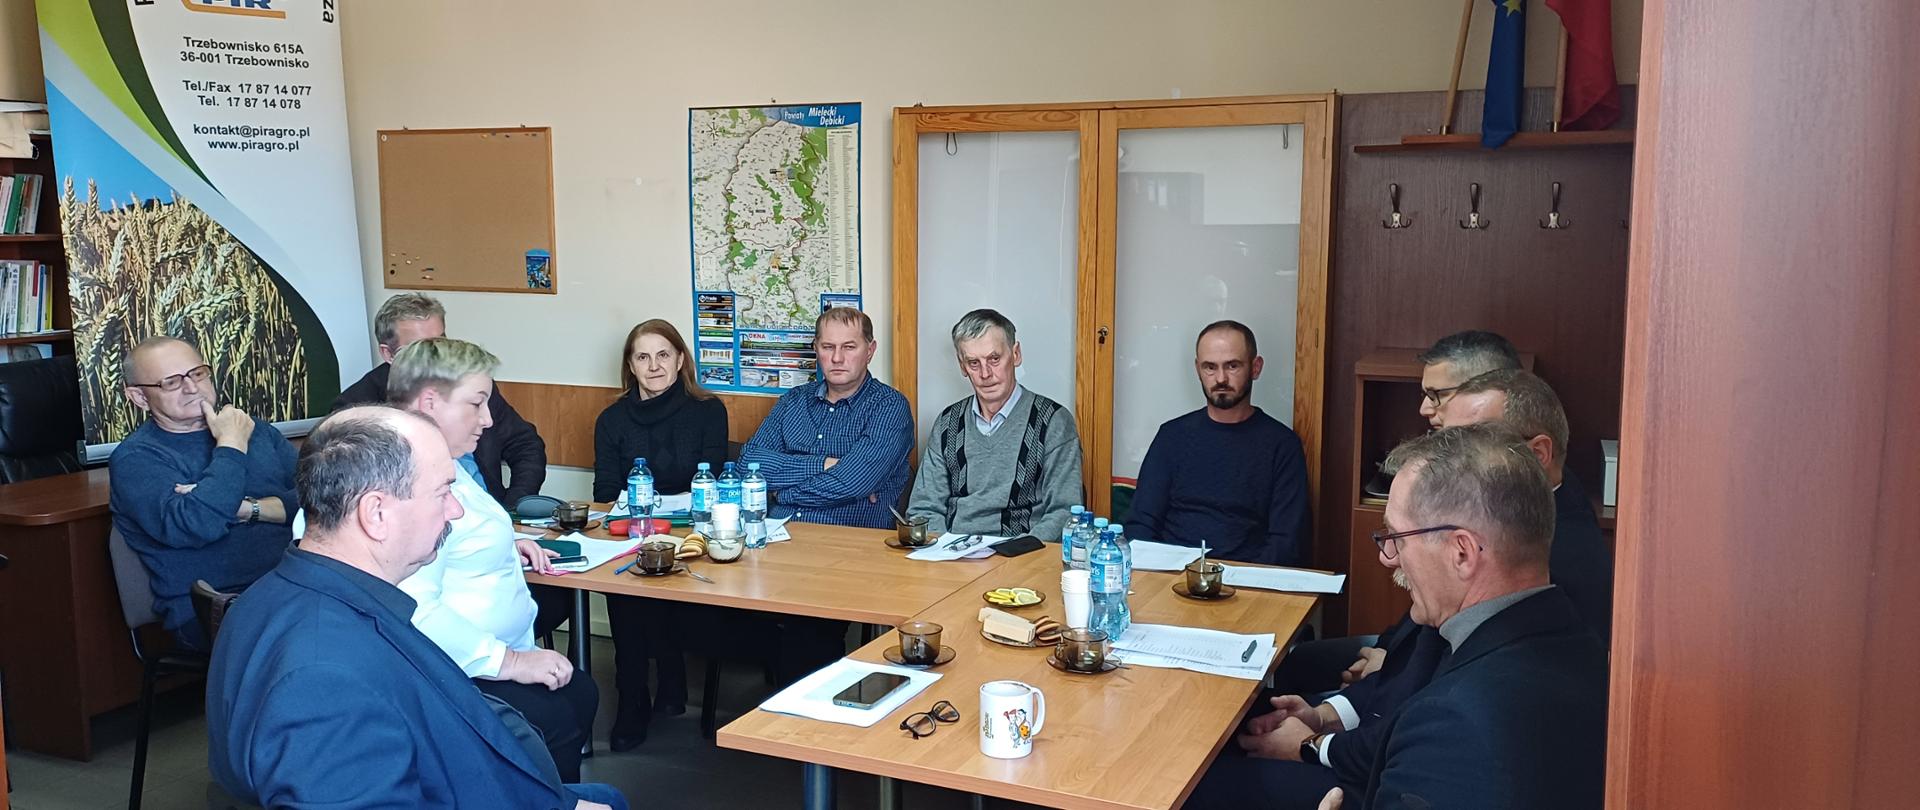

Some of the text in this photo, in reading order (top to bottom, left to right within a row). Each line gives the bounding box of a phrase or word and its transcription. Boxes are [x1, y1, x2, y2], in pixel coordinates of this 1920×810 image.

[183, 36, 304, 55] Trzebownisko 615A
[180, 51, 310, 69] 36-001 Trzebownisko
[182, 80, 312, 96] Tel./Fax 17 87 14 077
[197, 95, 301, 109] Tel. 17 87 14 078
[808, 106, 837, 117] Mielecki
[820, 115, 846, 127] Dębicki
[193, 124, 310, 139] kontakt@piragro.pl
[208, 140, 299, 152] www.piragro.pl
